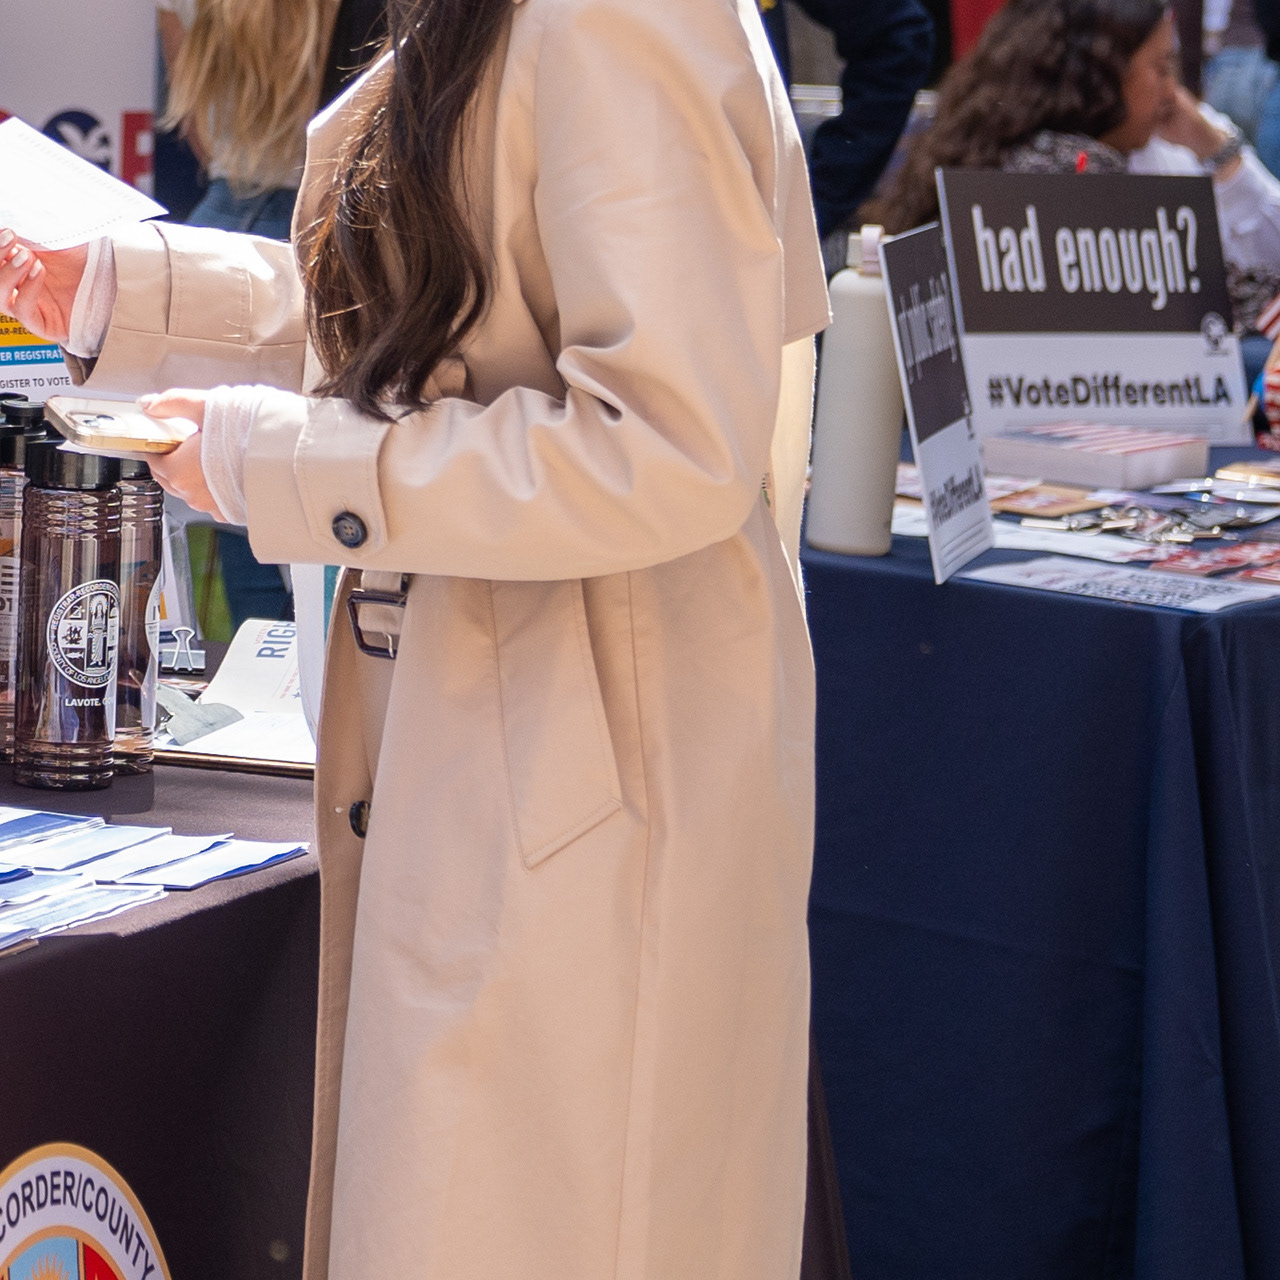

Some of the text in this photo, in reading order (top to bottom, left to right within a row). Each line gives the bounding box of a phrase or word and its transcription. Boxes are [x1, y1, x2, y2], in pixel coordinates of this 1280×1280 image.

[971, 204, 1201, 311] had enough?
[14, 349, 62, 361] REGISTRAT
[32, 378, 44, 388] TO
[46, 376, 70, 386] VOTE
[987, 375, 1232, 409] #VoteDifferentLA
